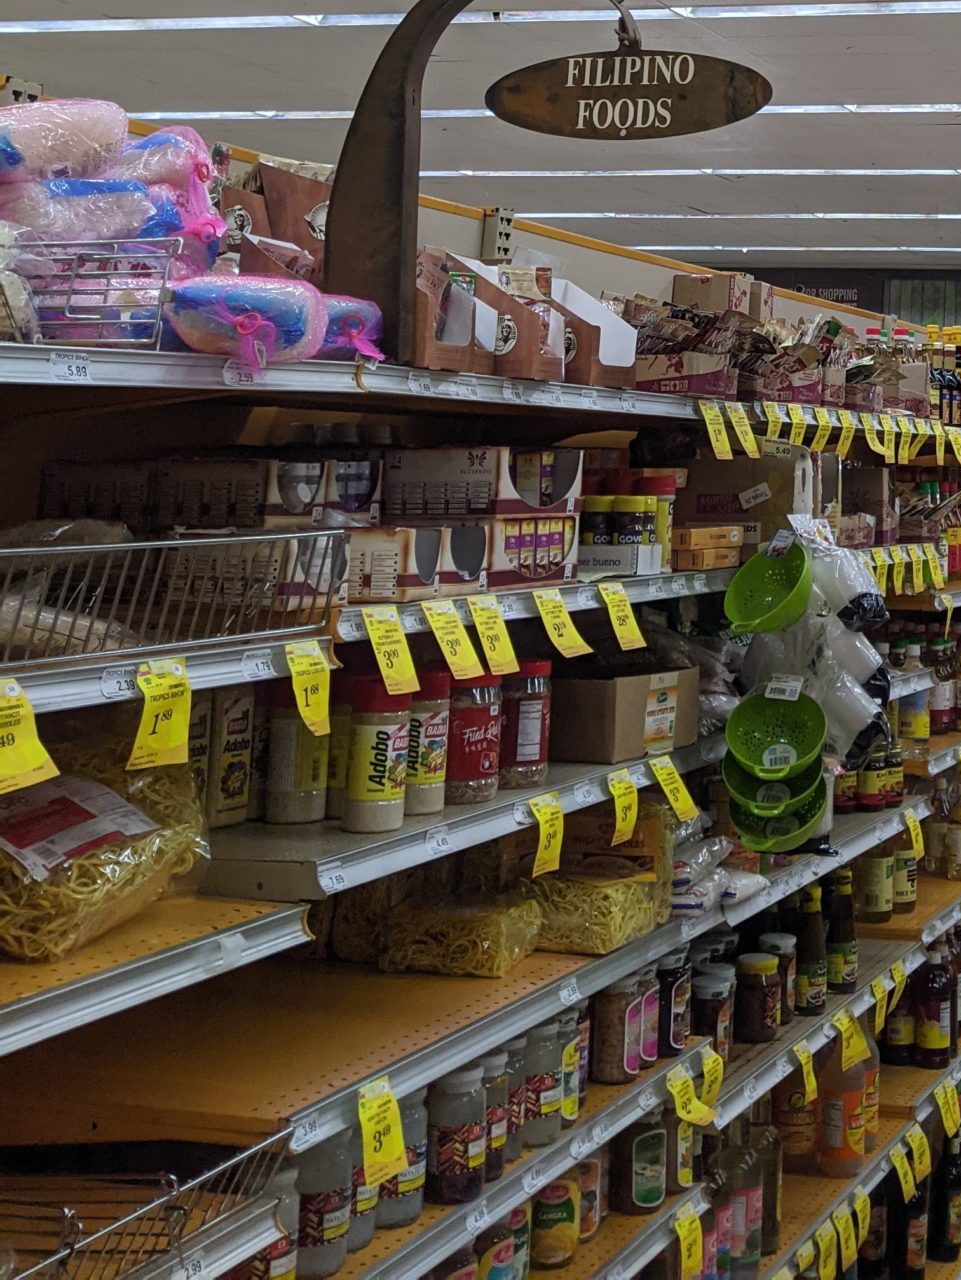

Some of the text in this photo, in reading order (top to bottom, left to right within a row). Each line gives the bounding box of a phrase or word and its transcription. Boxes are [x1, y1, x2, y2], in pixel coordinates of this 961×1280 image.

[564, 54, 695, 87] FILIPINO
[575, 98, 672, 130] FOODS
[775, 446, 791, 455] 5.49
[591, 556, 622, 568] bueno
[116, 678, 136, 692] 2.39
[368, 730, 390, 788] Adobo
[301, 1121, 318, 1137] 3.99
